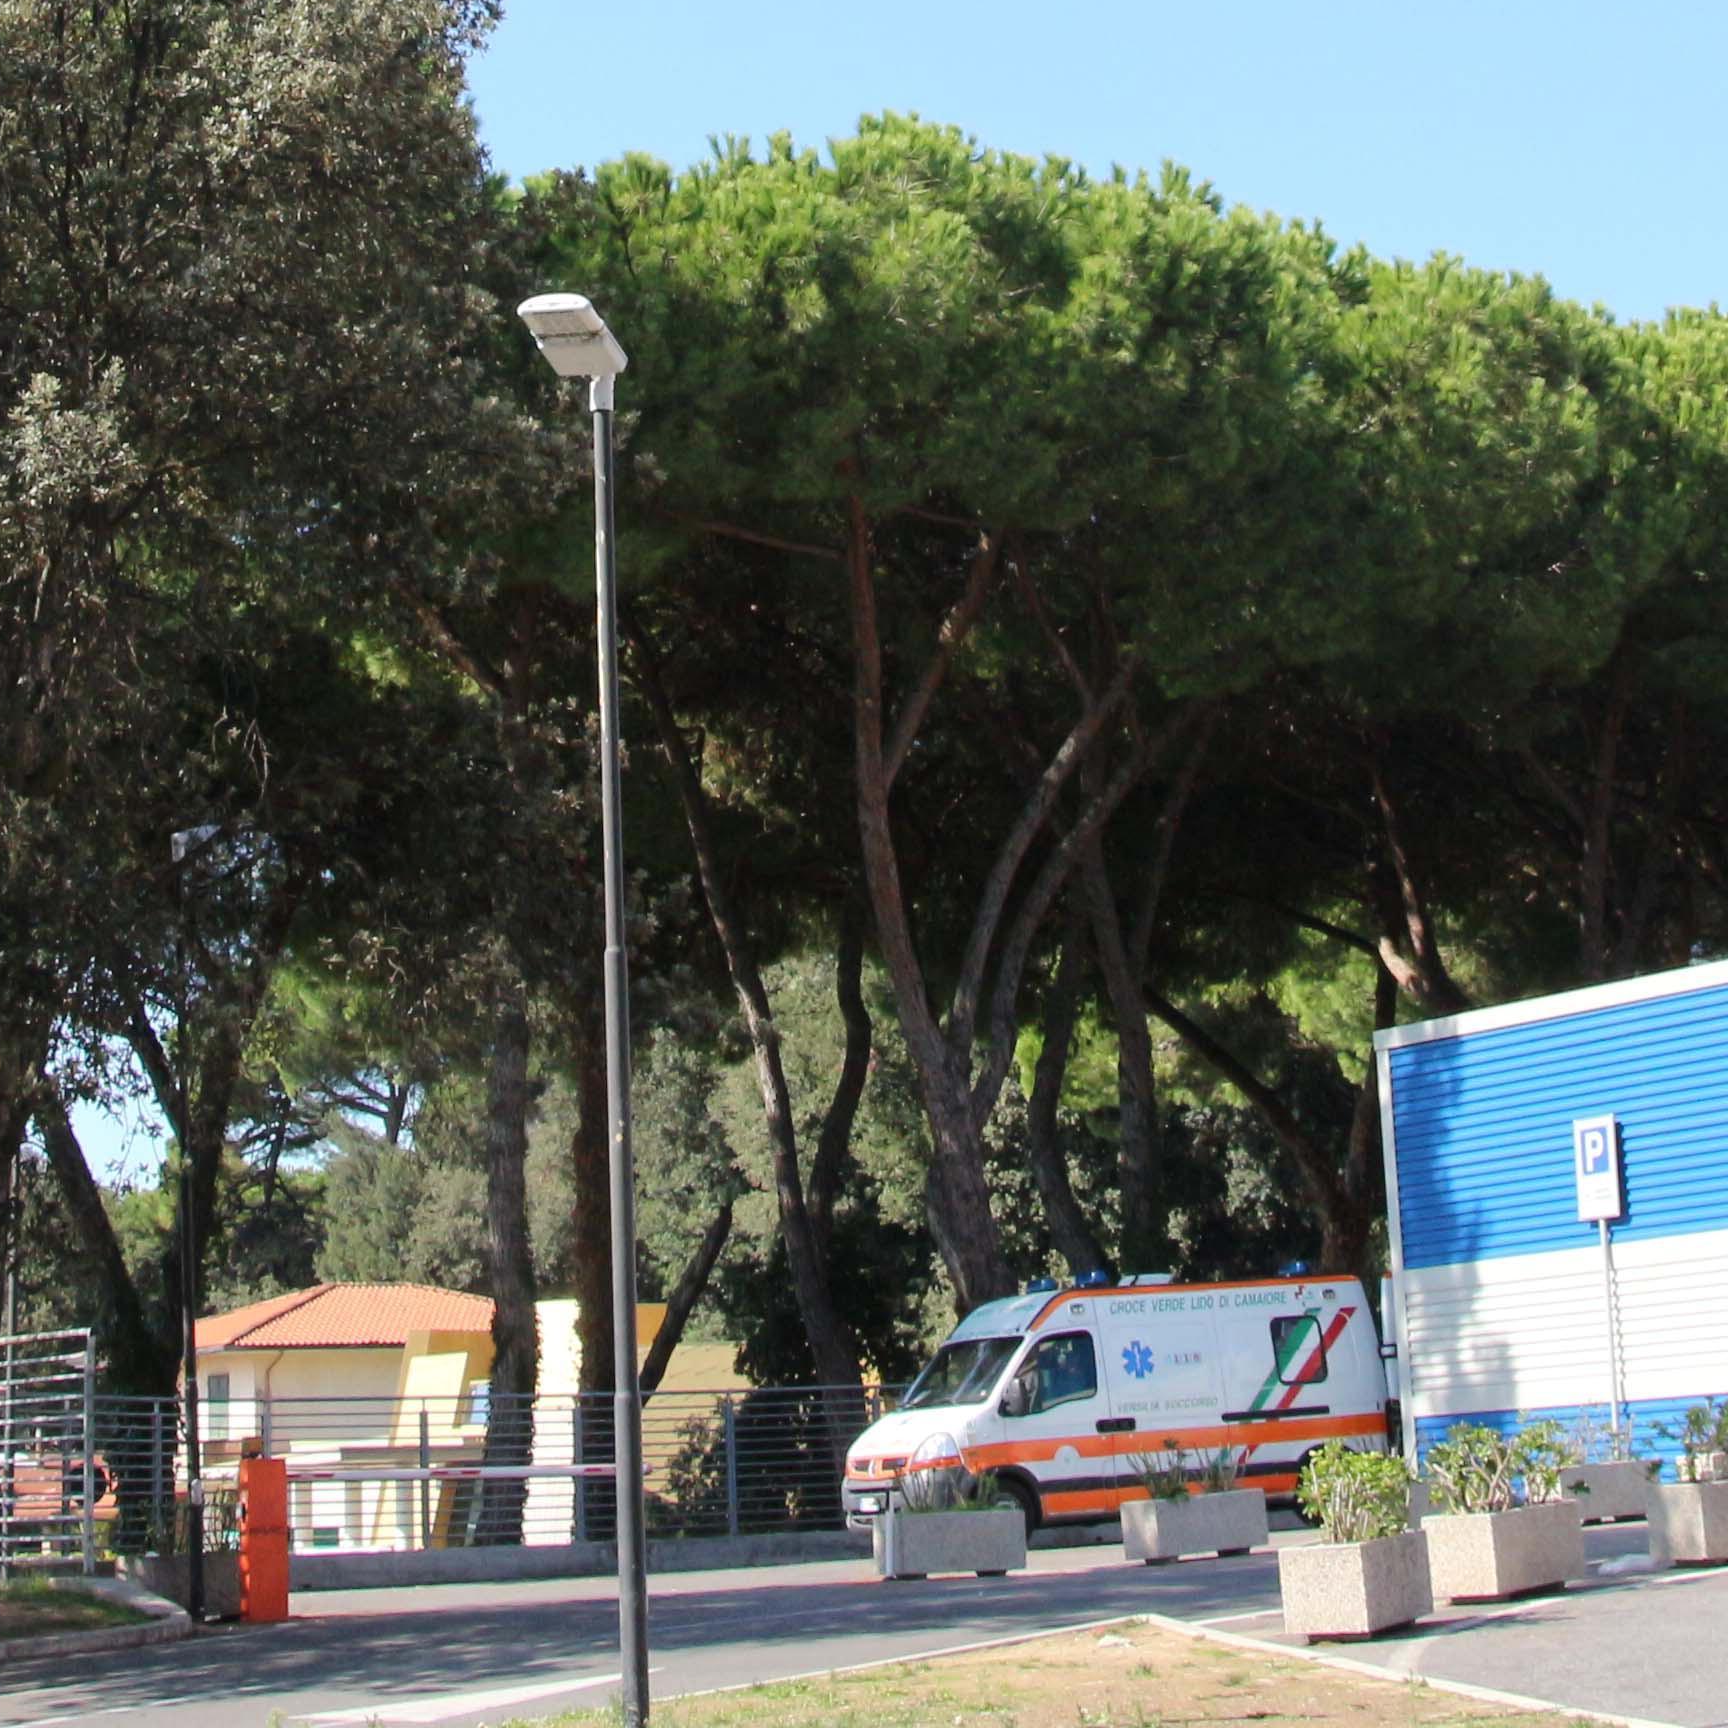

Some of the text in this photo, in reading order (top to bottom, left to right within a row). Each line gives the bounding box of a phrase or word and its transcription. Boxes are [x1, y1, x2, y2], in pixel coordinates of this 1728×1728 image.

[1584, 1130, 1604, 1173] P
[1110, 1290, 1288, 1315] CROCE VERDE LIDO DI CAMAIORE
